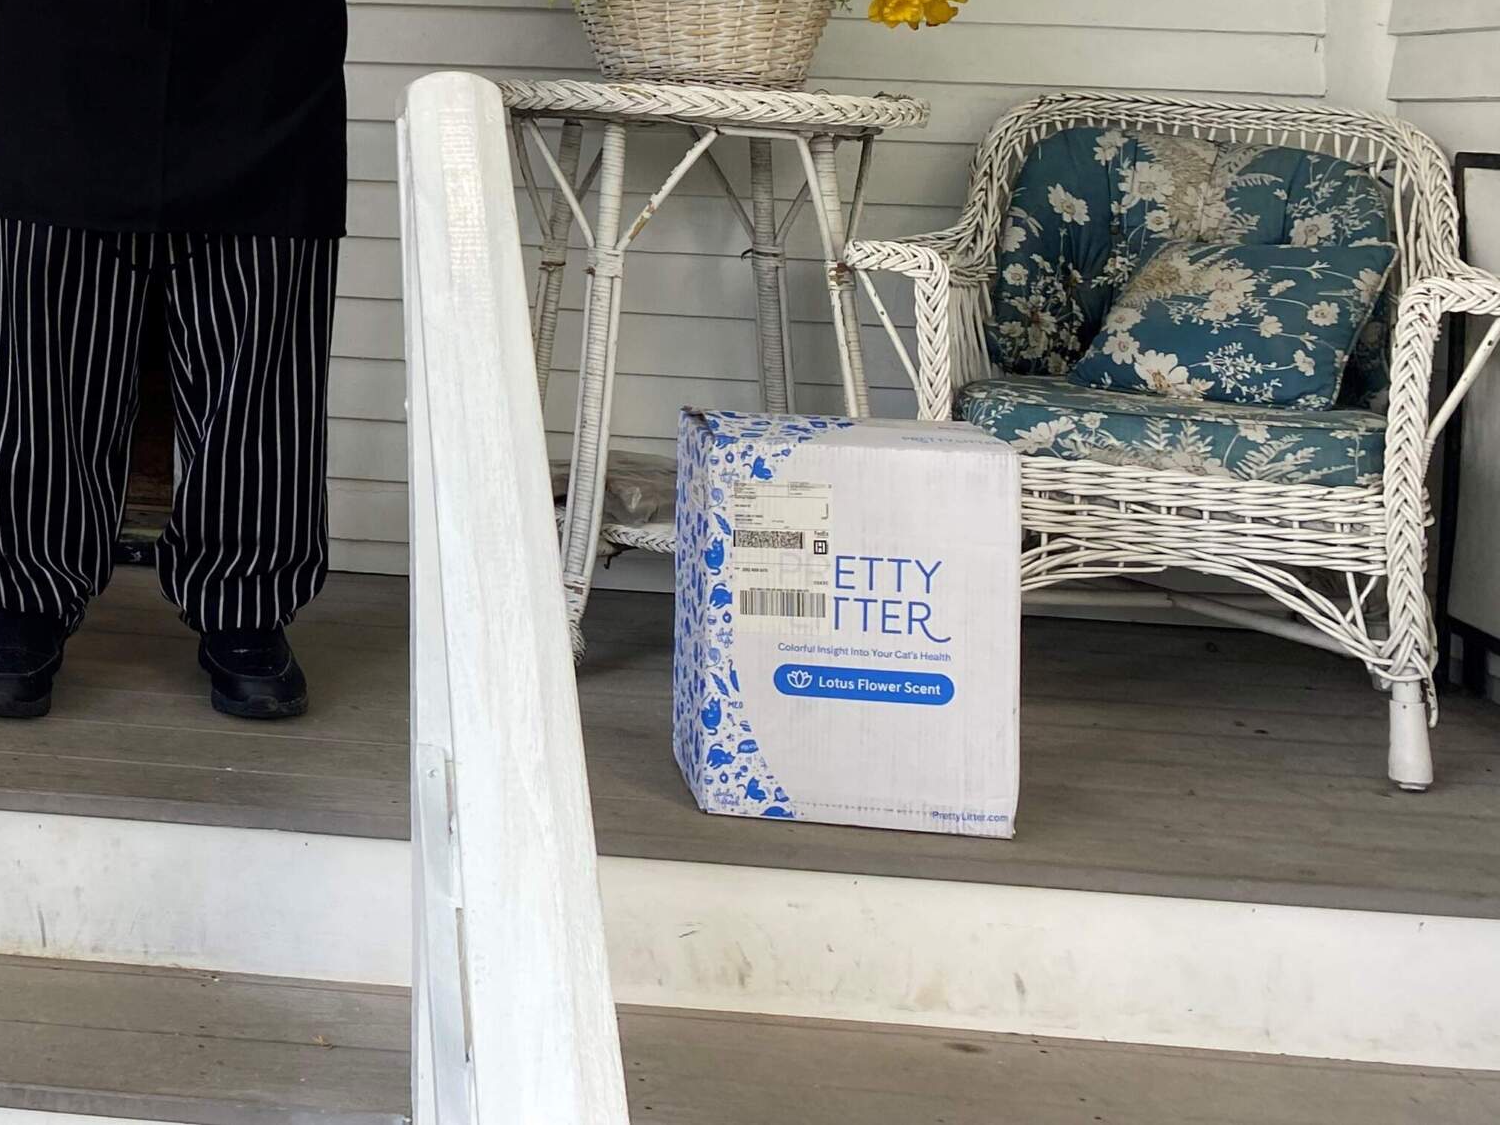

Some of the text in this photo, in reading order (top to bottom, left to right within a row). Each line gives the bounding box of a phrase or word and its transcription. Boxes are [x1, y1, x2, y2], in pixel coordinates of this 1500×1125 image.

[835, 555, 942, 594] ETTY
[833, 596, 952, 643] TTER
[777, 642, 952, 662] Colorful Insight Into Your Cat's Health
[818, 675, 941, 696] Lotus Flower Scent
